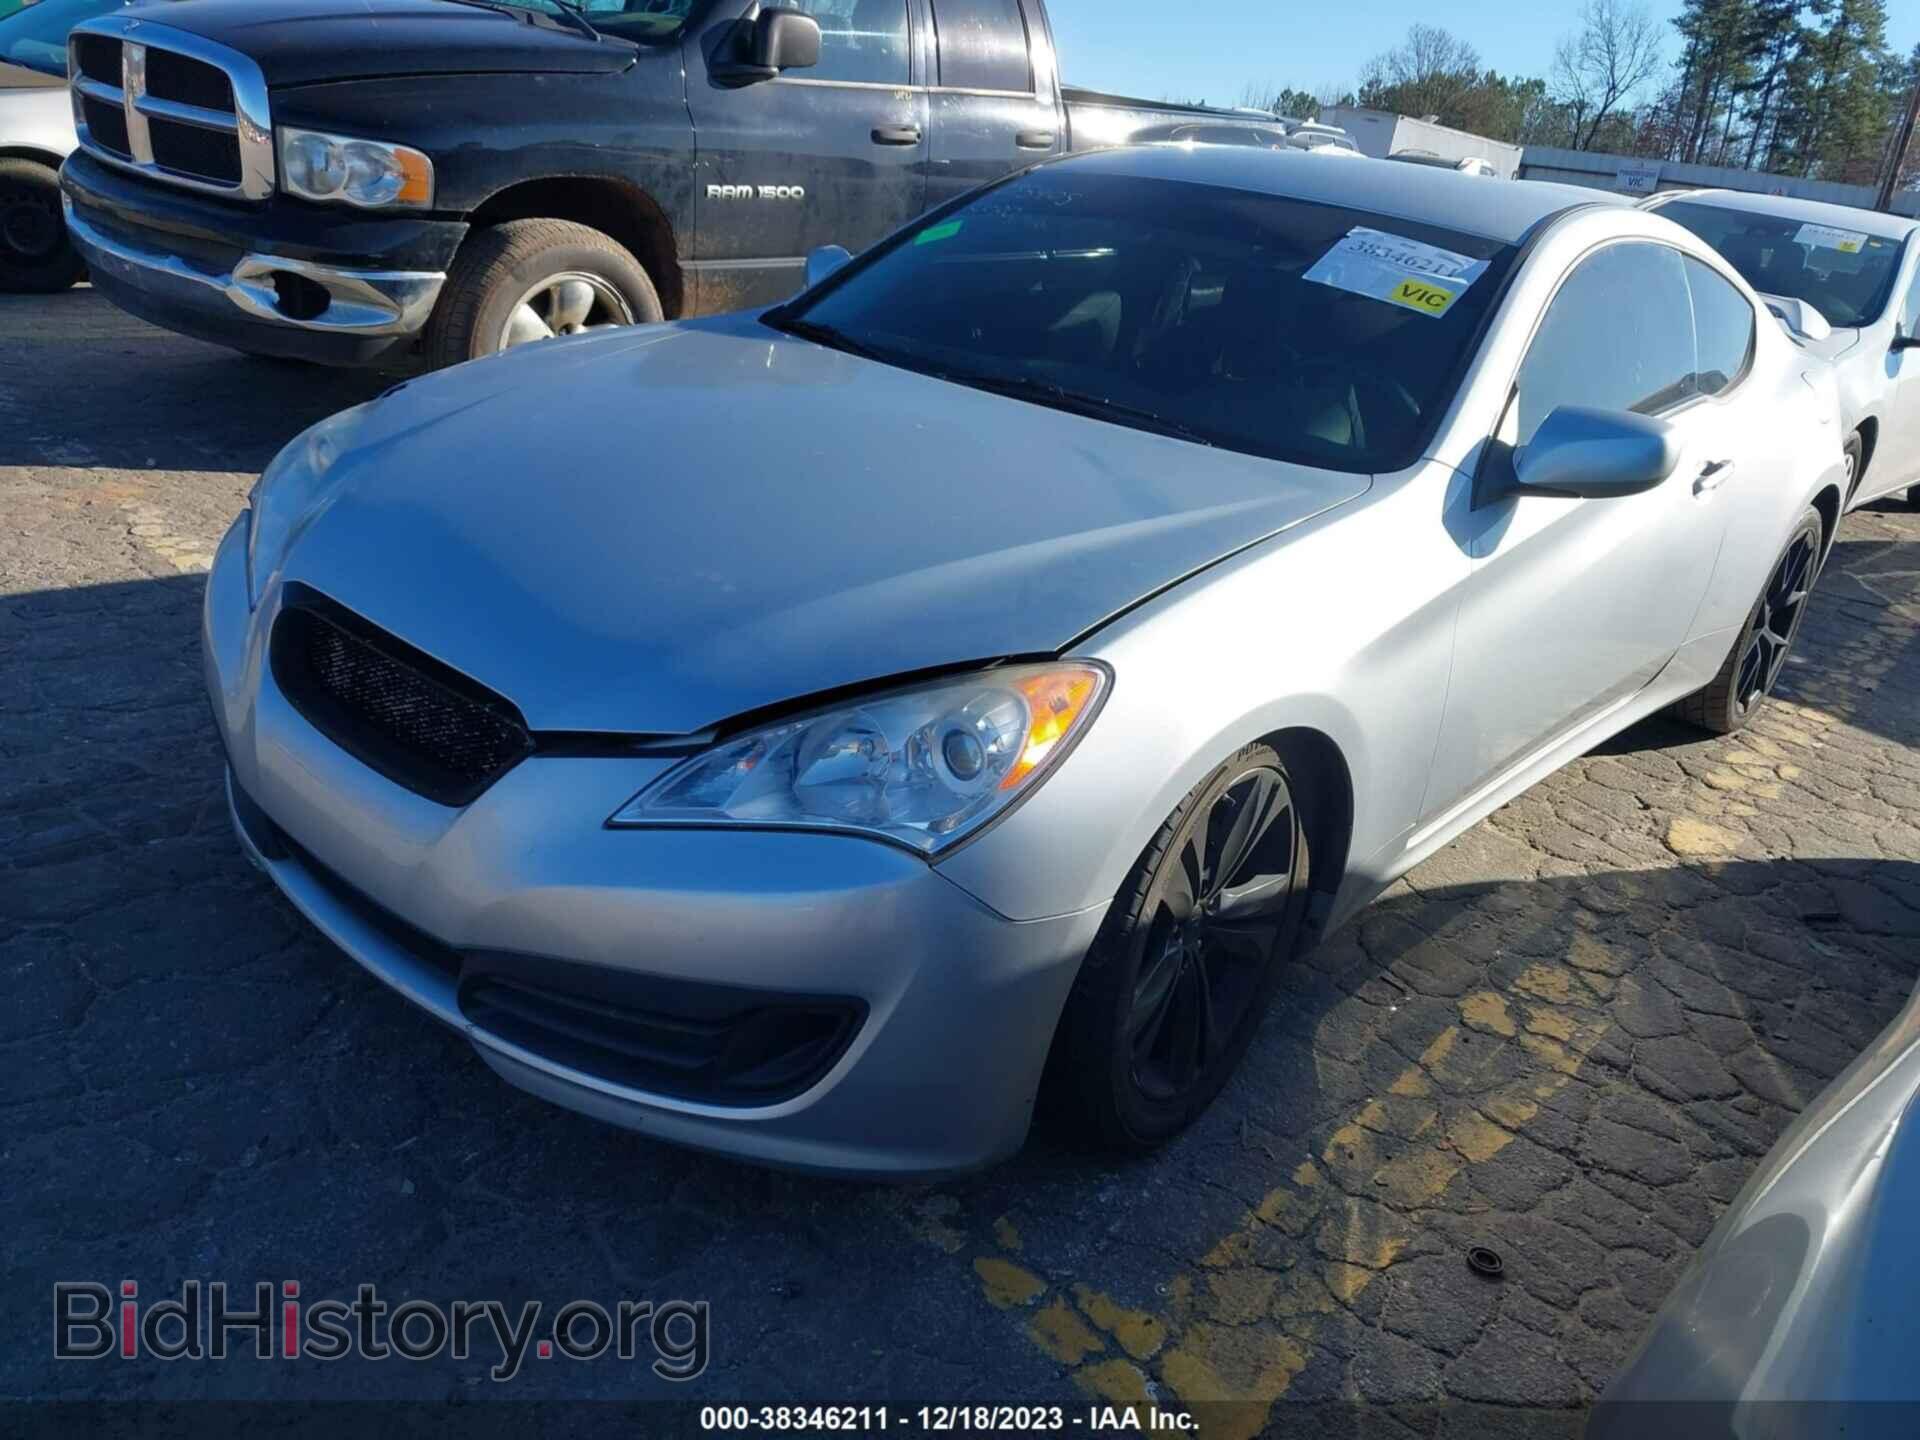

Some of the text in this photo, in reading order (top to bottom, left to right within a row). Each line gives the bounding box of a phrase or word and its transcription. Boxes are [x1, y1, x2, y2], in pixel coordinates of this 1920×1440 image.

[704, 184, 805, 200] RAM 1500
[1401, 283, 1446, 307] VIC
